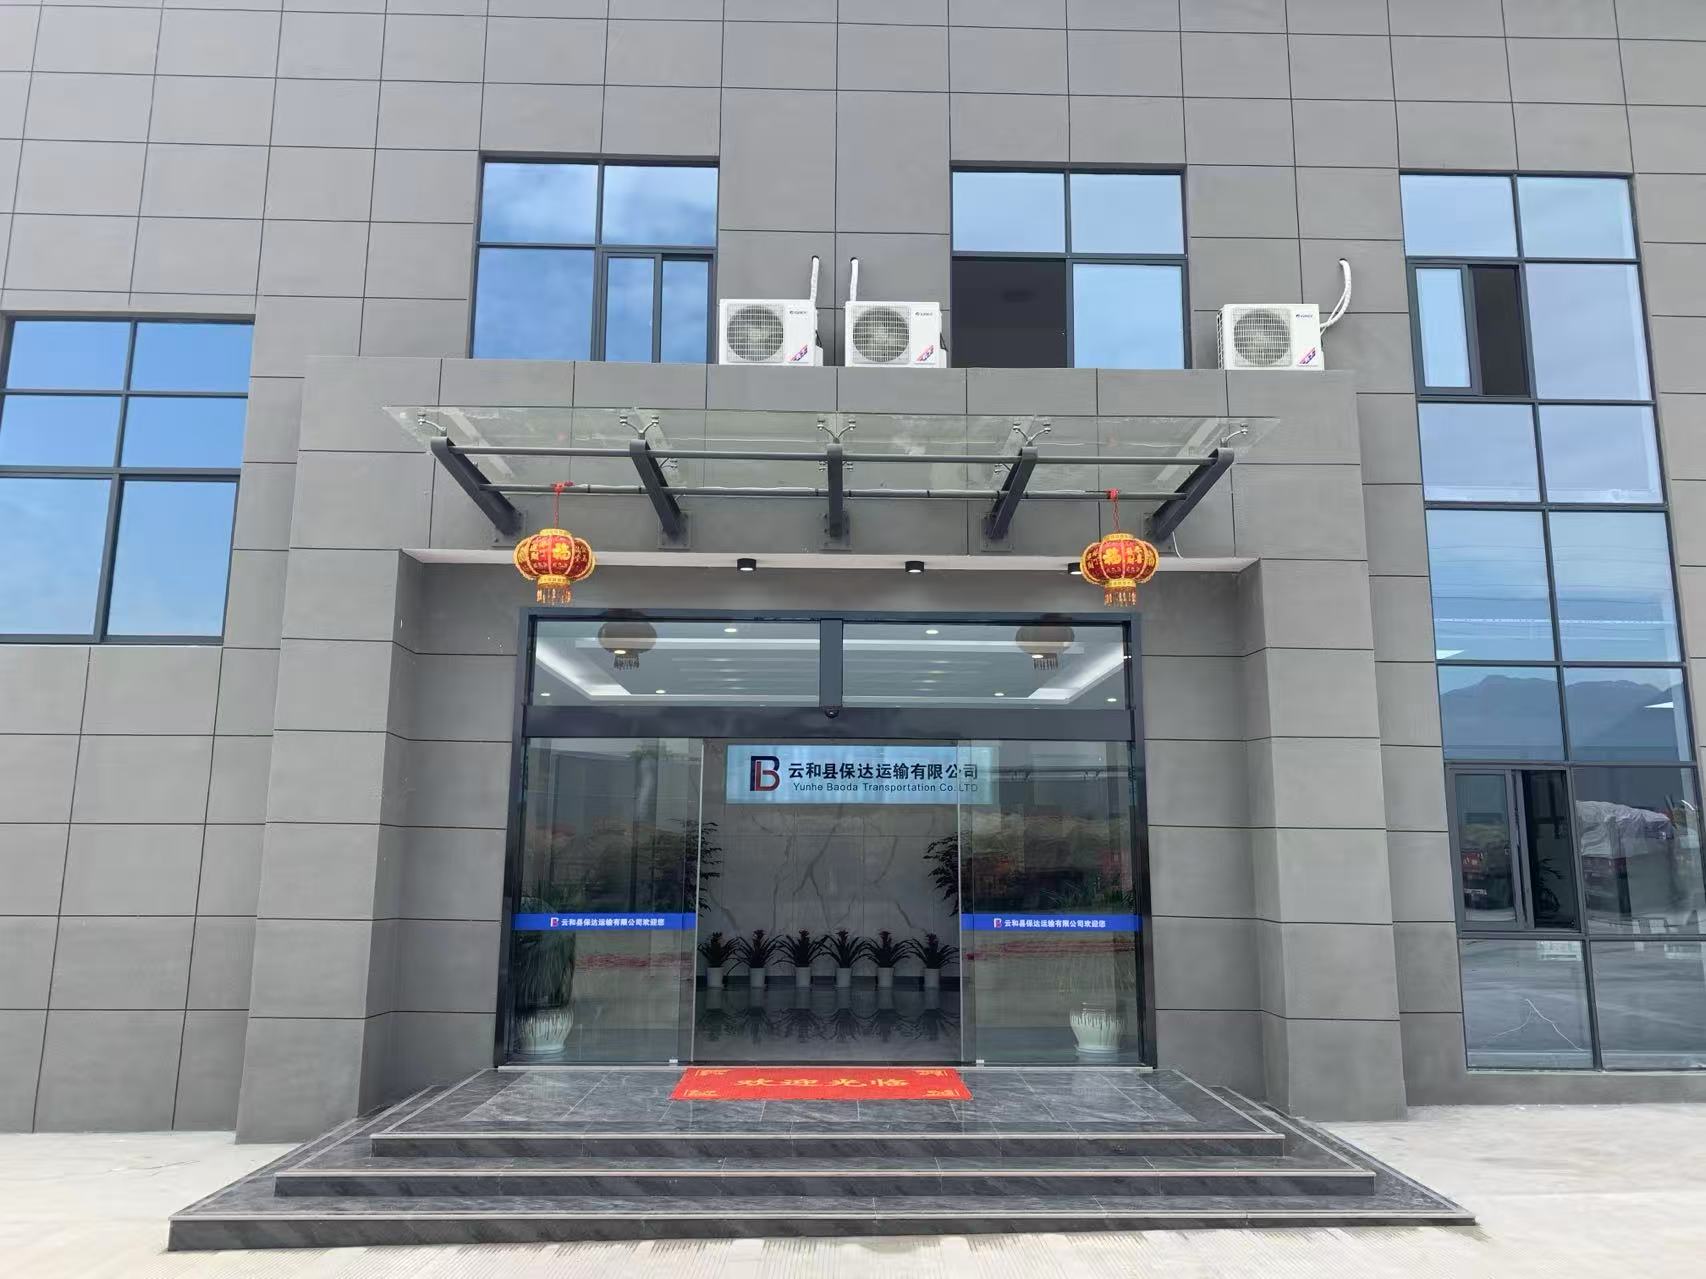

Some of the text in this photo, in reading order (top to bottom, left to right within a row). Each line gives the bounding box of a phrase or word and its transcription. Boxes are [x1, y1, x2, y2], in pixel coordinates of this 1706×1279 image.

[788, 762, 978, 780] 云和县保达运输有限公司
[793, 782, 823, 792] Yunhe
[826, 782, 858, 792] Baoda
[862, 782, 936, 793] Transportation
[736, 1078, 909, 1087] 欢迎光临
